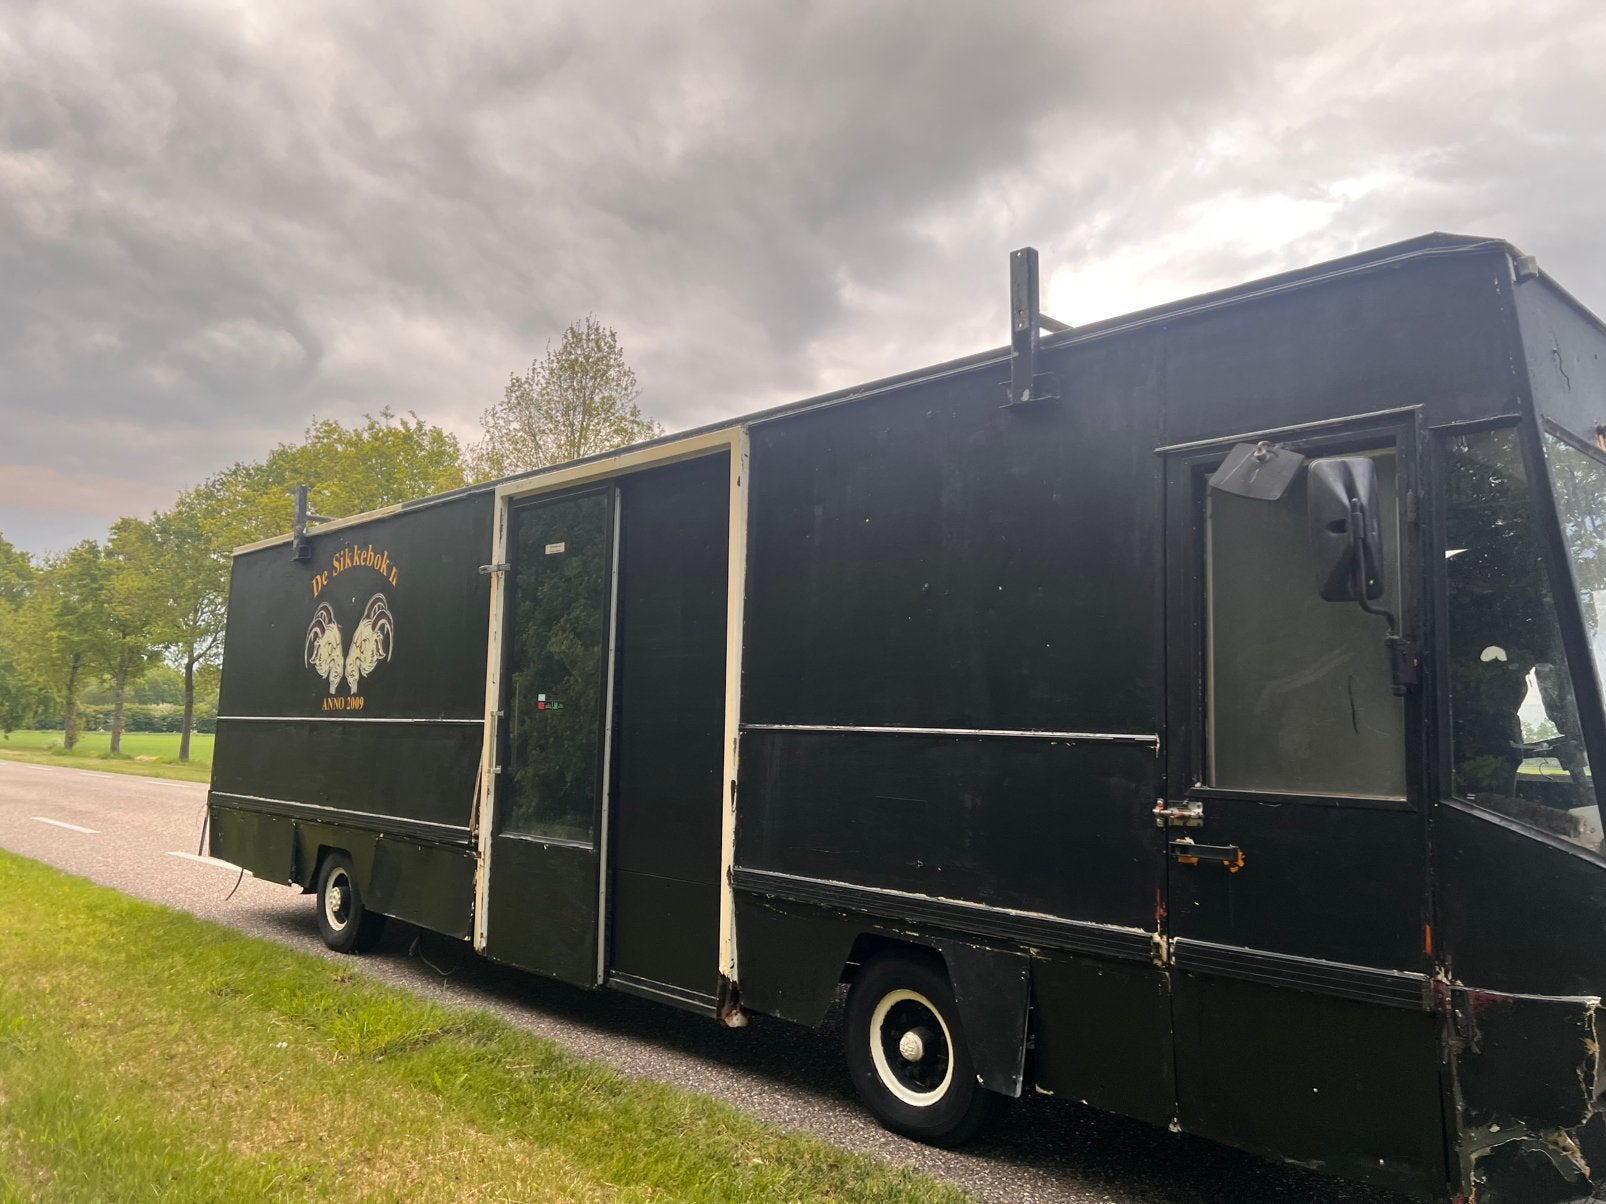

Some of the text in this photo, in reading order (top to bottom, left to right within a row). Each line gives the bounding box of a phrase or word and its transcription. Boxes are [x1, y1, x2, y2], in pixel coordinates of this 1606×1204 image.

[312, 570, 328, 598] De
[322, 696, 364, 711] ANNO 2009
